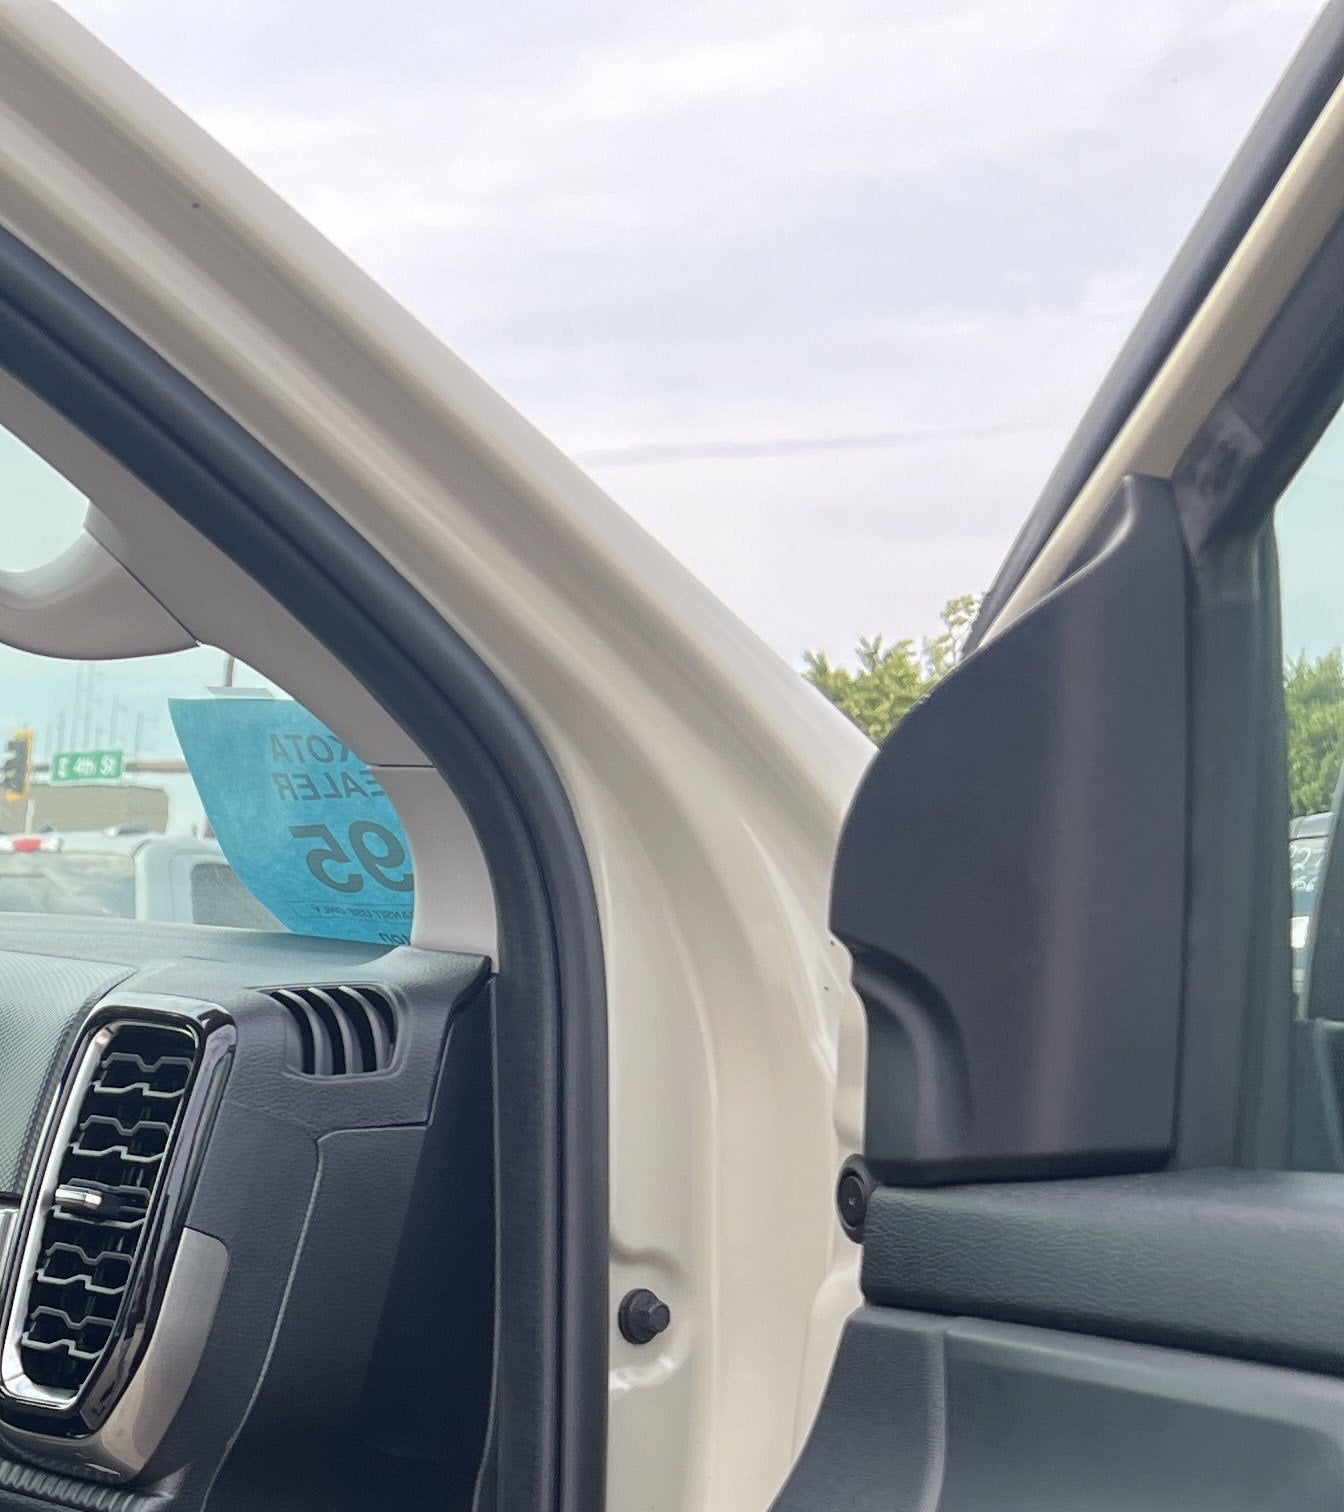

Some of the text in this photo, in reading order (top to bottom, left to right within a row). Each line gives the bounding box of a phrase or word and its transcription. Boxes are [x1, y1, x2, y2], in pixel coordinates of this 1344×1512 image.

[57, 754, 118, 779] E 4th St
